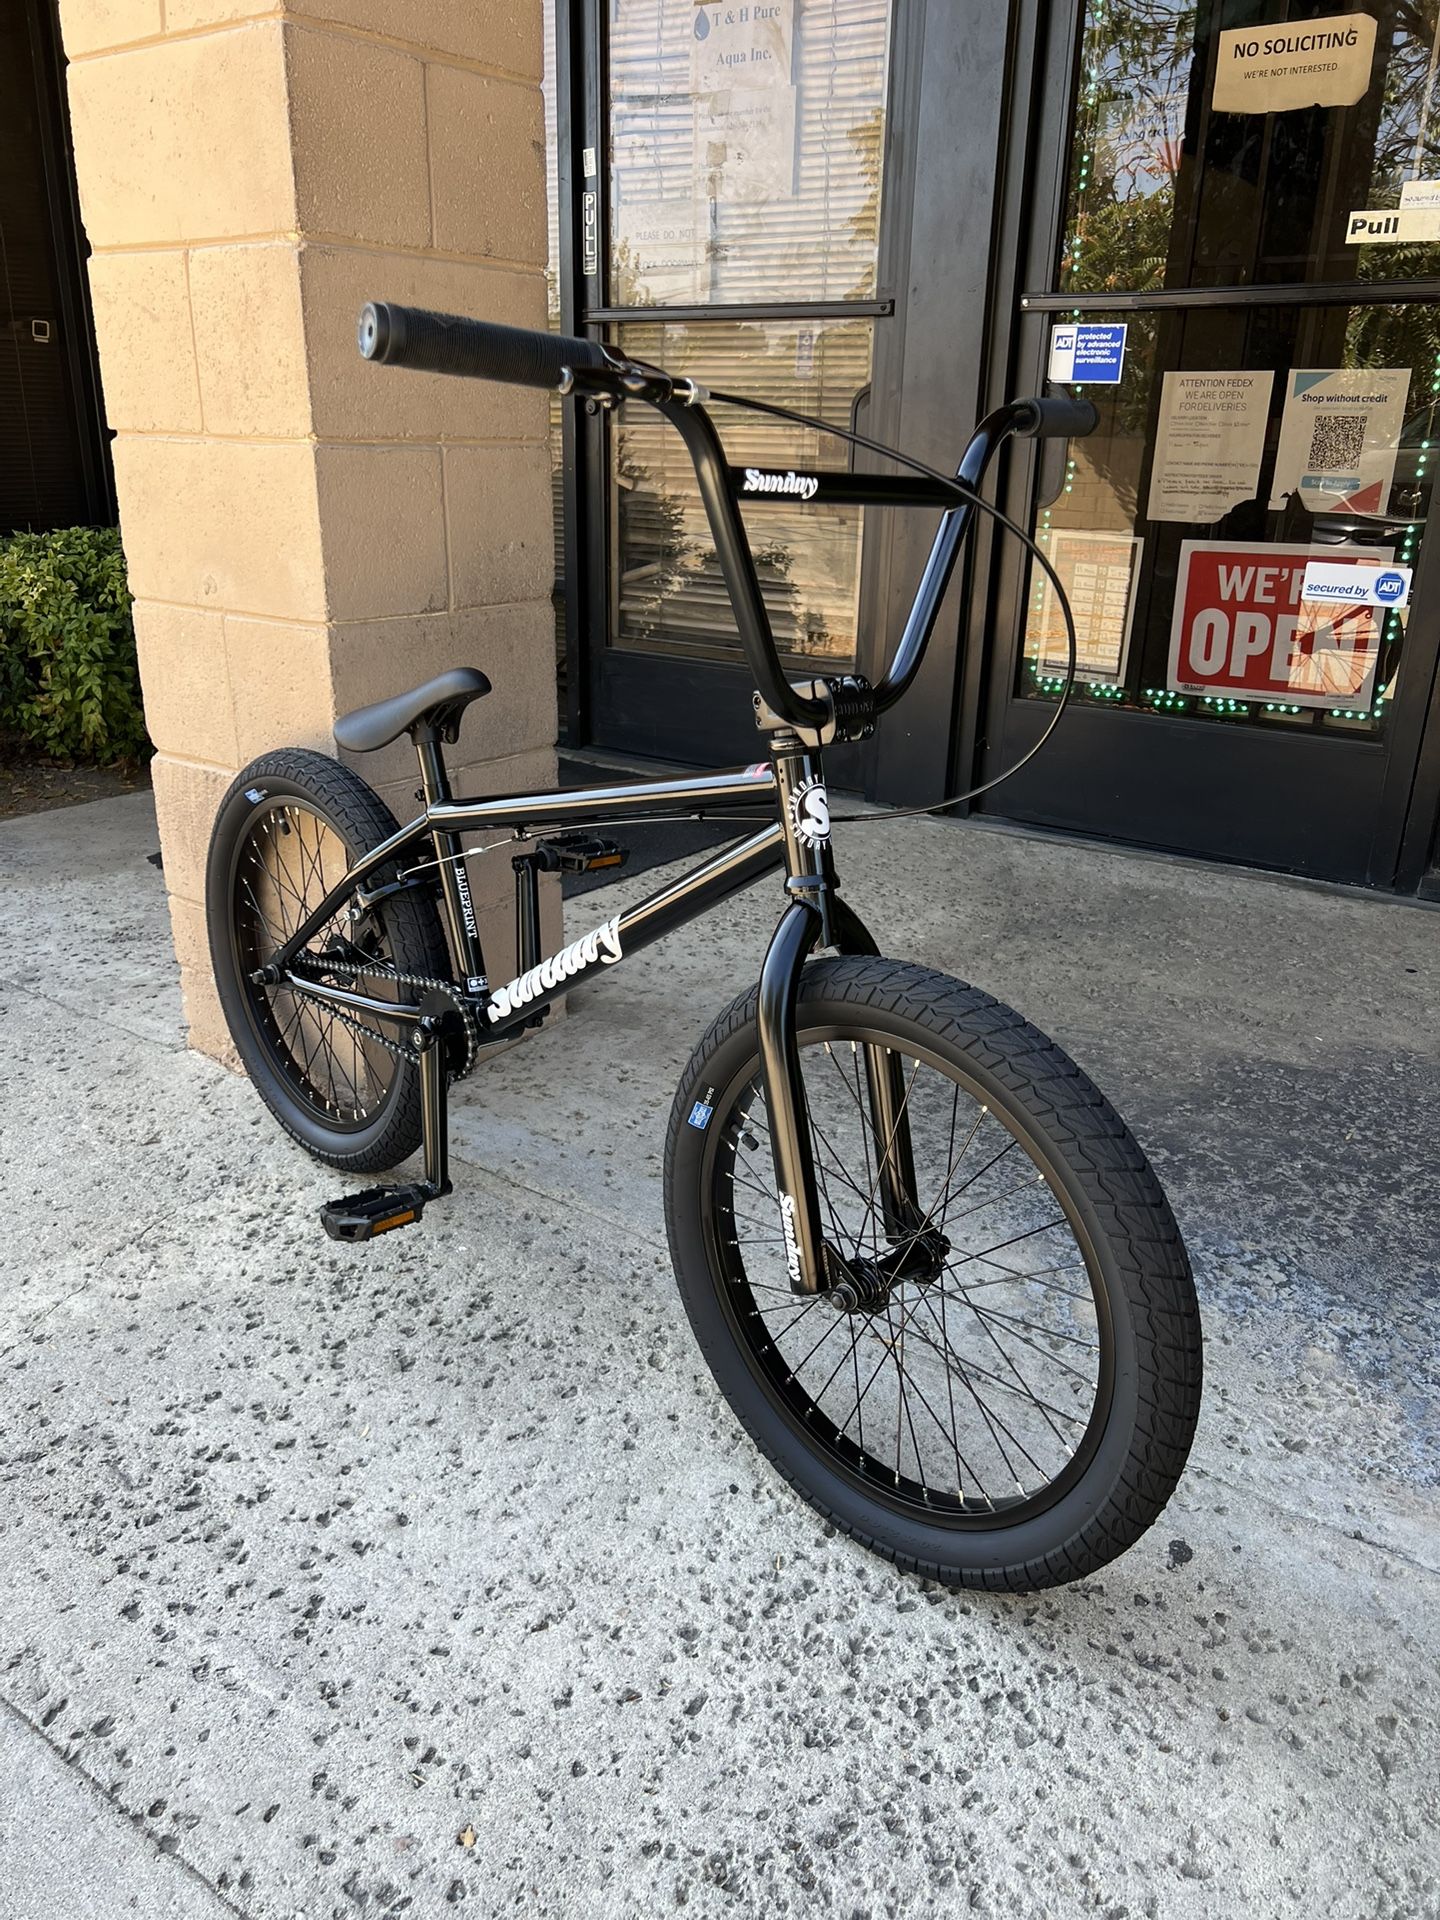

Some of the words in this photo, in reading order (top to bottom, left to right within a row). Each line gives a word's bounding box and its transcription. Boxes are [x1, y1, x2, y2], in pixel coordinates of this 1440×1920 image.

[713, 12, 721, 26] T
[725, 10, 735, 24] &
[740, 7, 749, 22] H
[754, 6, 781, 20] Pure
[1233, 41, 1259, 59] NO
[1263, 28, 1359, 55] SOLICITING
[716, 53, 746, 68] Aqua
[751, 47, 772, 61] Inc.
[1244, 68, 1268, 79] WE'RE
[1270, 67, 1288, 77] NOT
[585, 194, 595, 256] PULL
[1350, 217, 1400, 235] Pull
[636, 230, 661, 241] PLEASE
[663, 229, 675, 240] DO
[1056, 336, 1073, 349] ADT
[1077, 332, 1113, 342] protected
[1077, 341, 1086, 350] by
[1086, 340, 1122, 349] advanced
[1076, 348, 1111, 357] electronic
[1075, 356, 1117, 365] surveillance
[1179, 379, 1225, 388] ATTENTION
[1226, 378, 1254, 388] FEDEX
[1185, 390, 1199, 400] WE
[1200, 390, 1216, 400] ARE
[1219, 390, 1244, 400] OPEN
[1301, 393, 1325, 404] Shop
[1326, 394, 1360, 403] without
[1361, 394, 1388, 403] credit
[743, 468, 819, 500] Sunday
[1306, 582, 1353, 594] secured
[1354, 583, 1369, 597] by
[1379, 580, 1400, 593] ADT
[455, 867, 478, 938] BLUEPRINT
